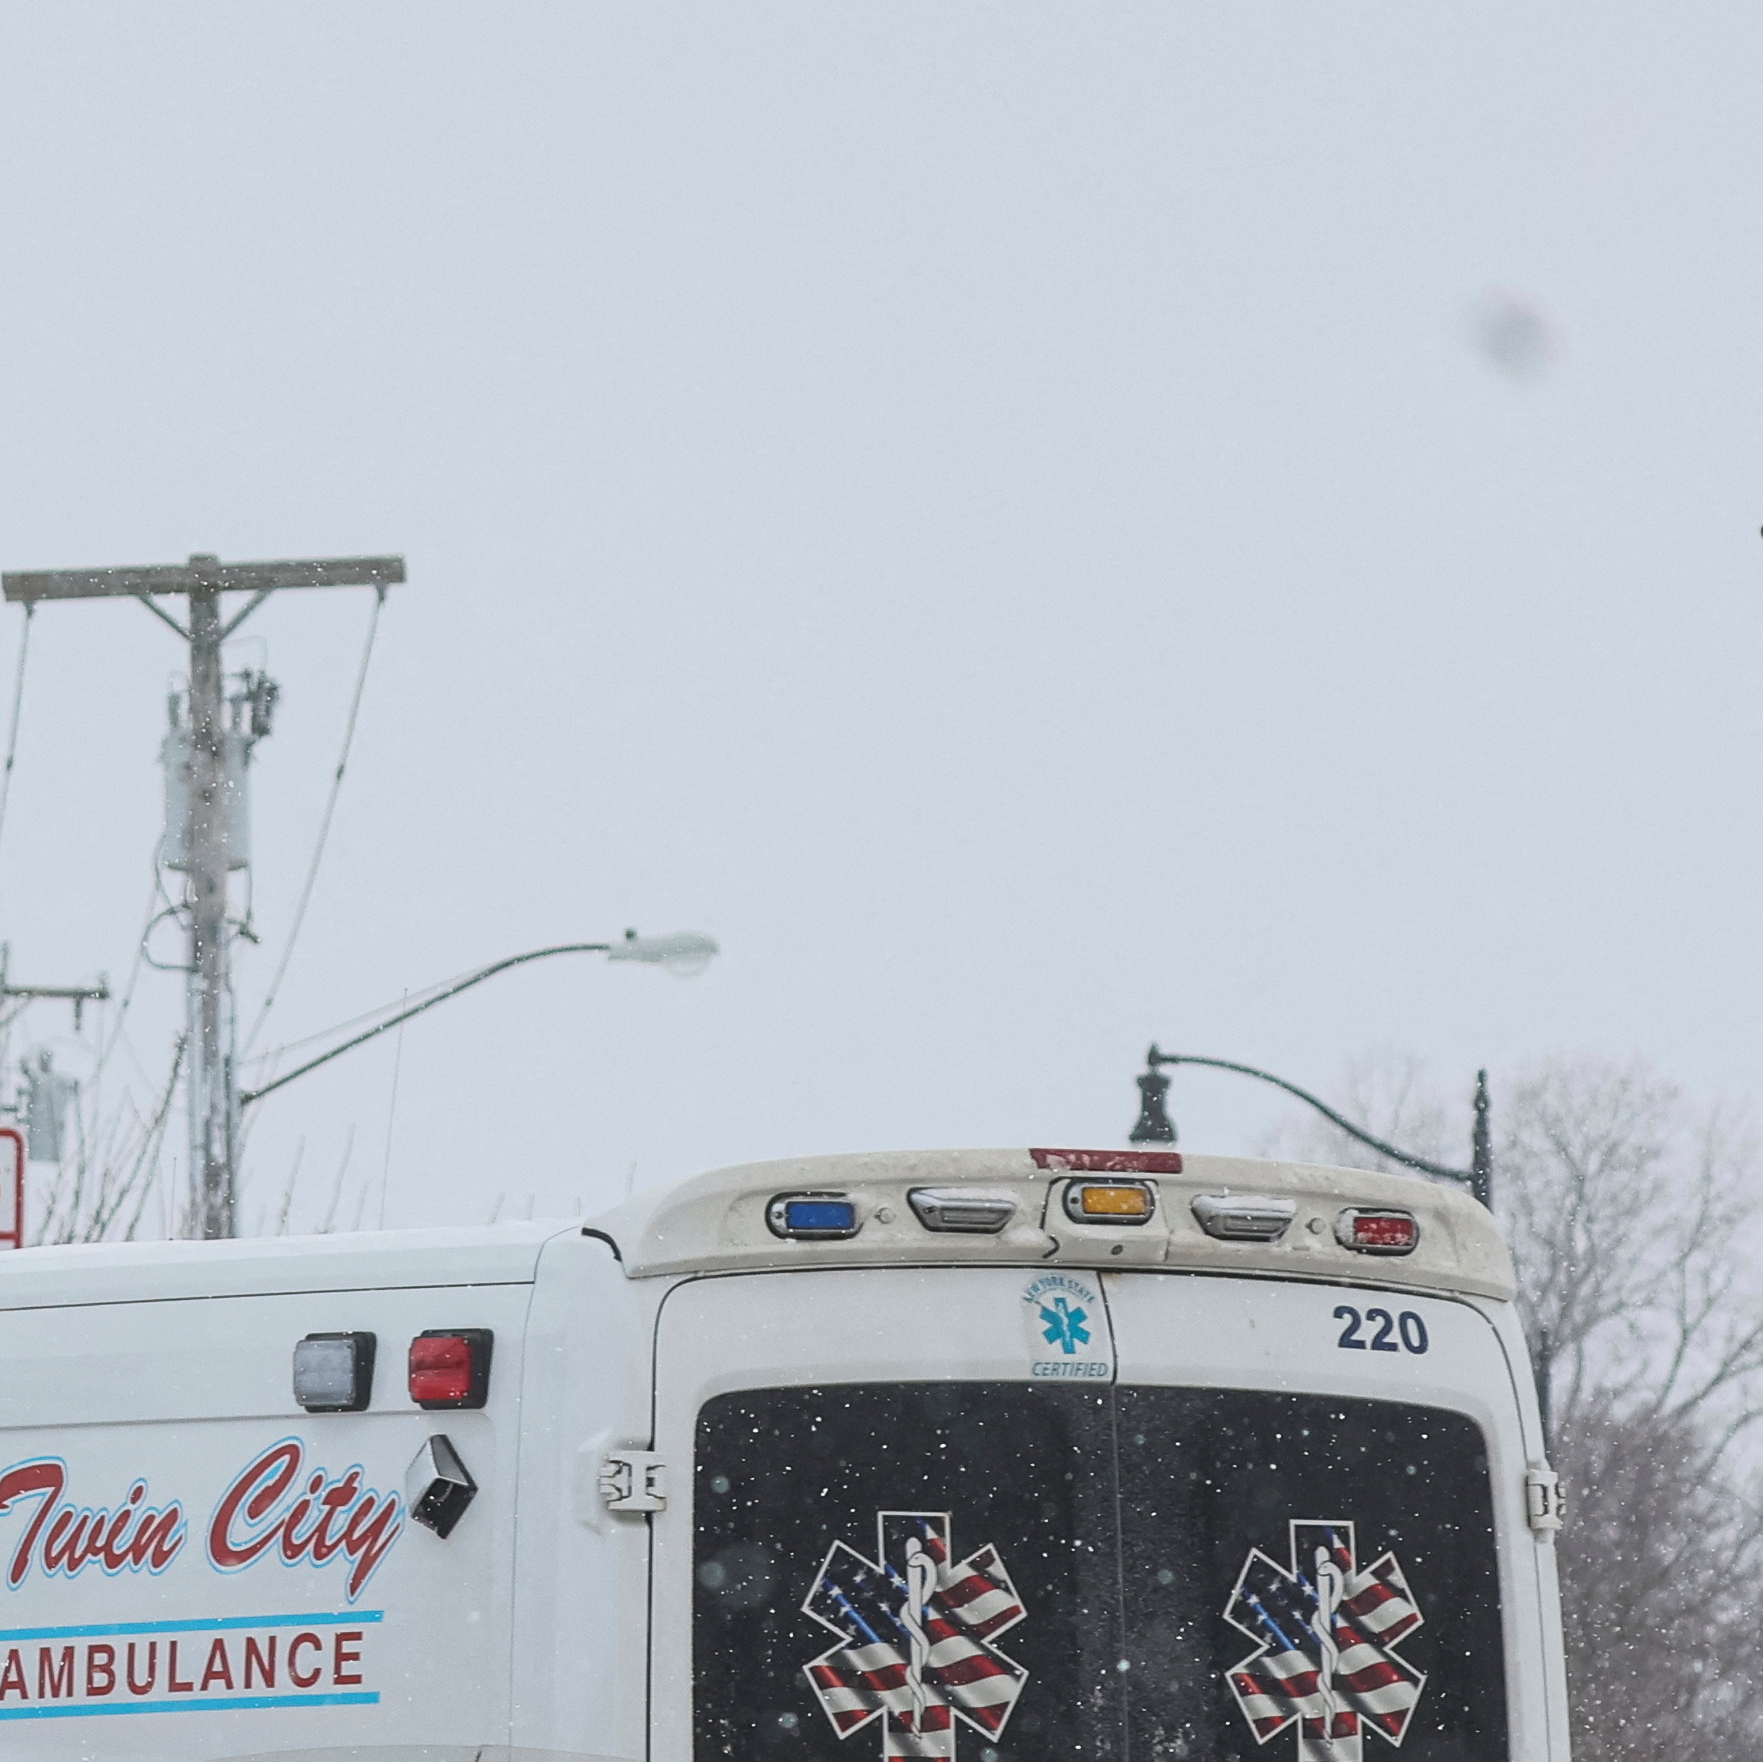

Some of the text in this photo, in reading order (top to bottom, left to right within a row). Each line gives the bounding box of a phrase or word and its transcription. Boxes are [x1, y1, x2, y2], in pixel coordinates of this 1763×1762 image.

[1333, 1305, 1429, 1355] 220
[1032, 1362, 1109, 1377] CERTIFIED
[208, 1438, 403, 1602] City
